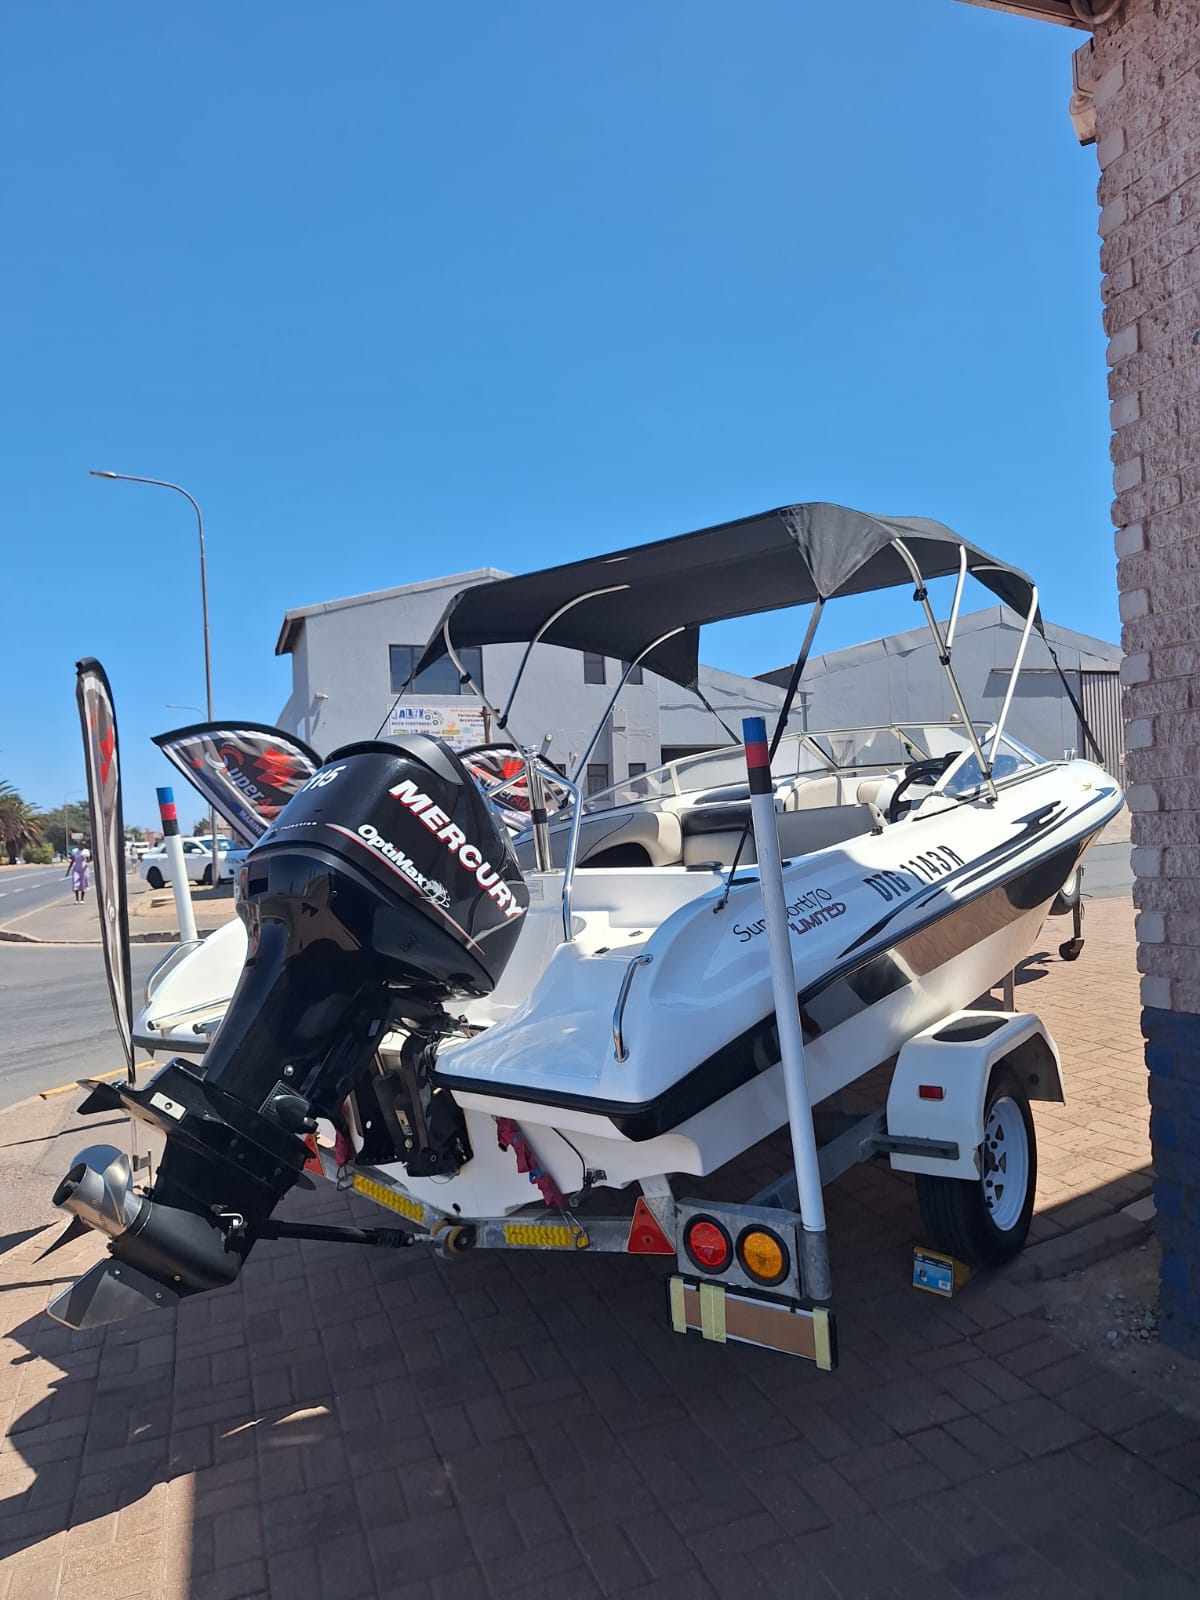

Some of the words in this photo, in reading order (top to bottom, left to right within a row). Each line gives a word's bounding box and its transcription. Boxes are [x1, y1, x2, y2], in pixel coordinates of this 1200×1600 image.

[302, 764, 347, 793] 115
[357, 824, 428, 887] OptiMax
[388, 779, 524, 919] MERCURY
[863, 871, 911, 902] DTG
[899, 851, 951, 886] 1143
